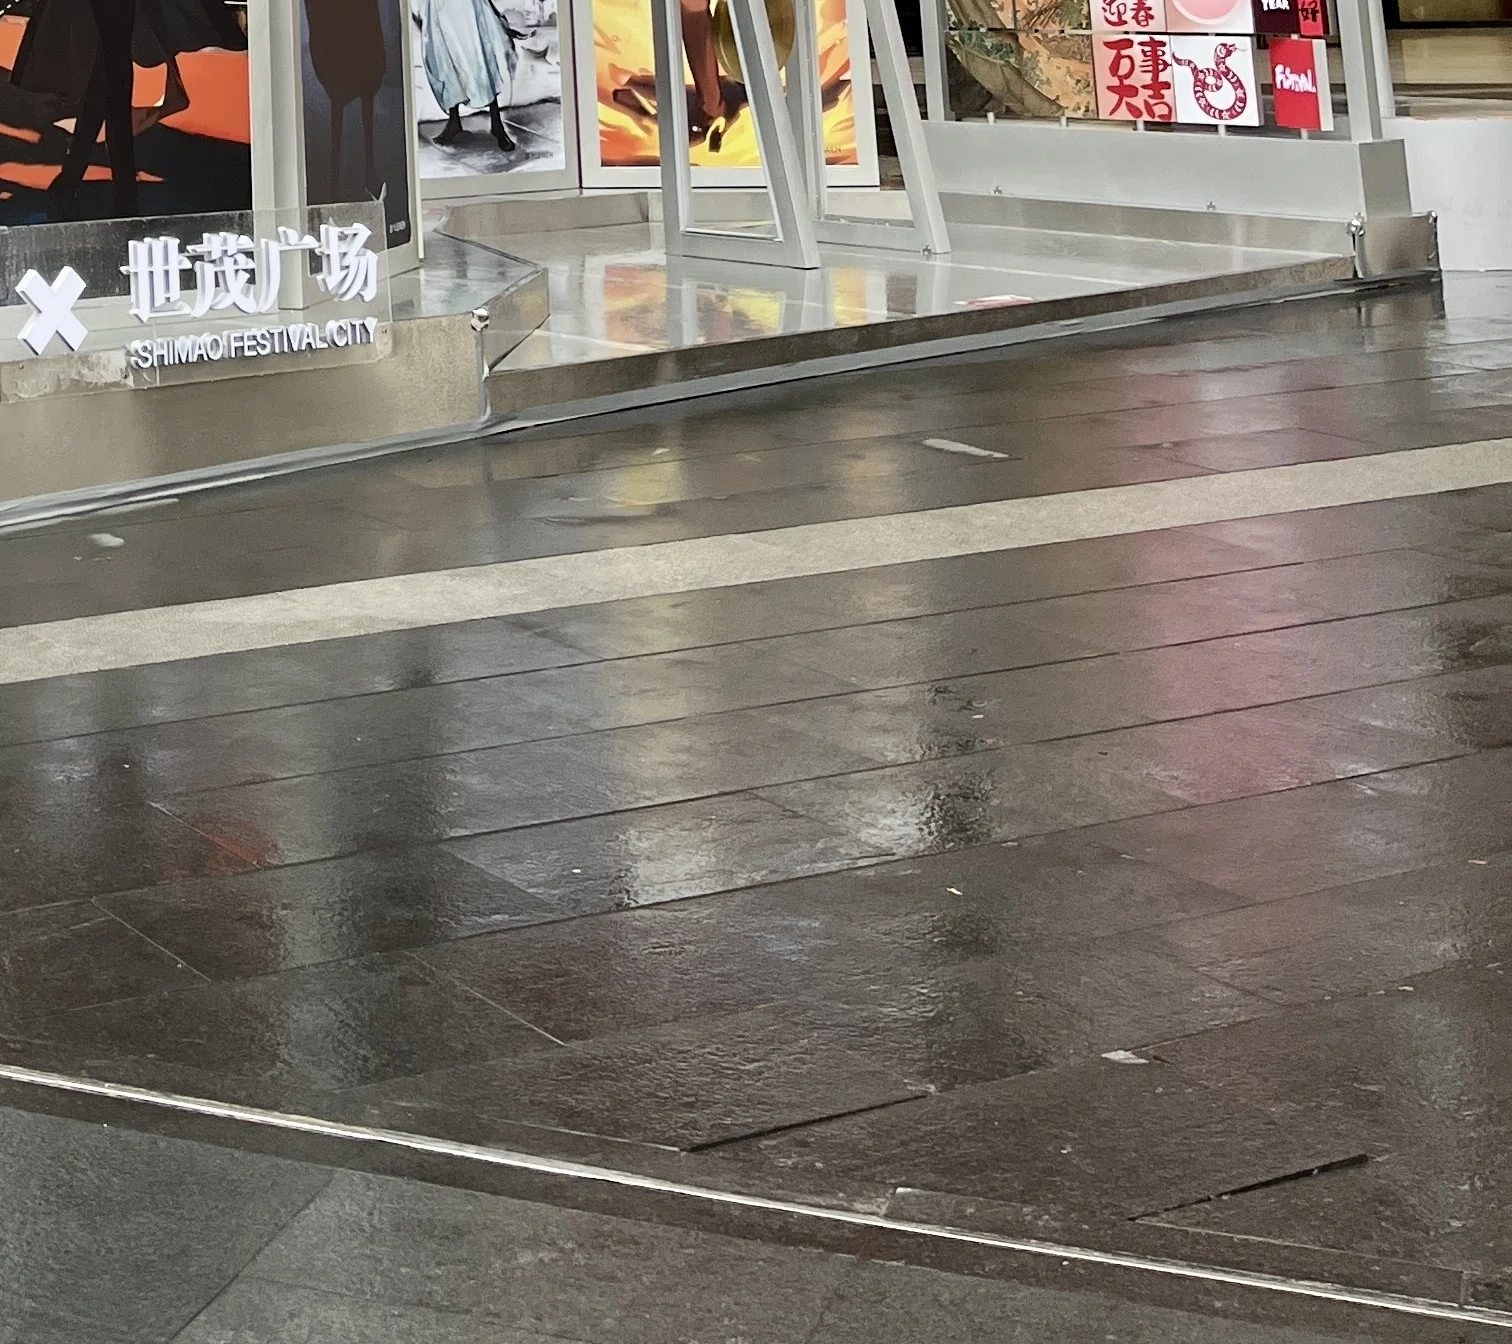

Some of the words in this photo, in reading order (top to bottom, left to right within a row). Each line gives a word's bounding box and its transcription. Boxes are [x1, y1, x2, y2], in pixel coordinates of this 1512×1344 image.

[120, 222, 380, 324] 世茂广场
[130, 328, 224, 371] SHIMAO
[228, 320, 328, 359] FESTIVAL
[325, 316, 379, 349] CITY
